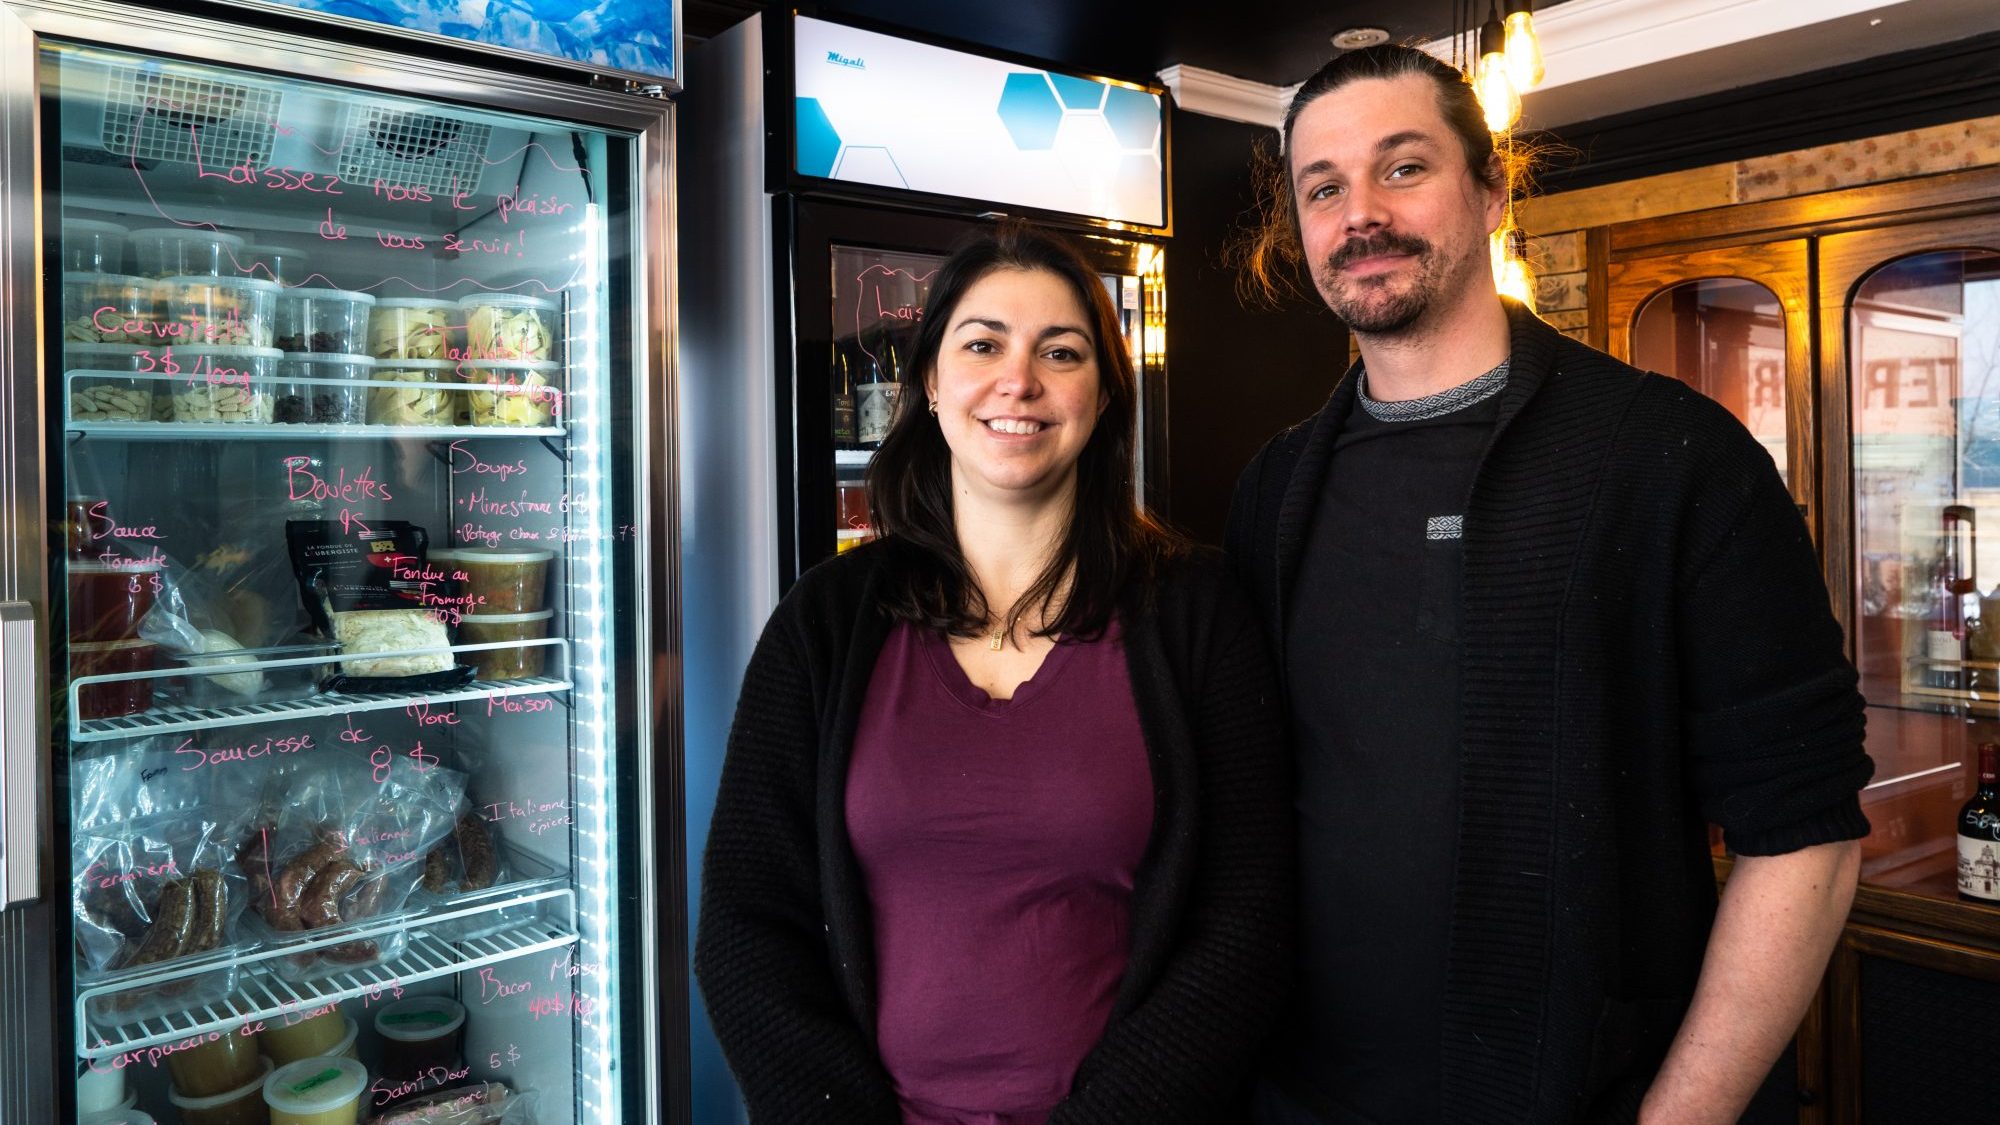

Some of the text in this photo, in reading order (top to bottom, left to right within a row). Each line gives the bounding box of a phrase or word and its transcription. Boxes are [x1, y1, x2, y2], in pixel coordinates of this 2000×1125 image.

[827, 51, 865, 68] Migali
[191, 124, 344, 195] Laissez
[453, 175, 478, 210] le
[497, 185, 574, 224] plaisir
[319, 207, 526, 258] de vous servir!
[284, 456, 393, 500] Boulettes
[88, 501, 168, 540] Sauce
[392, 556, 470, 582] Fondue au
[420, 582, 487, 615] Fromage
[176, 733, 316, 771] Saucisse
[407, 697, 461, 727] Porc
[487, 686, 553, 717] Maison
[479, 944, 600, 1004] Bacon Maiso
[88, 1031, 220, 1073] Carpaccio
[240, 1012, 267, 1036] de
[371, 1070, 425, 1106] Saint
